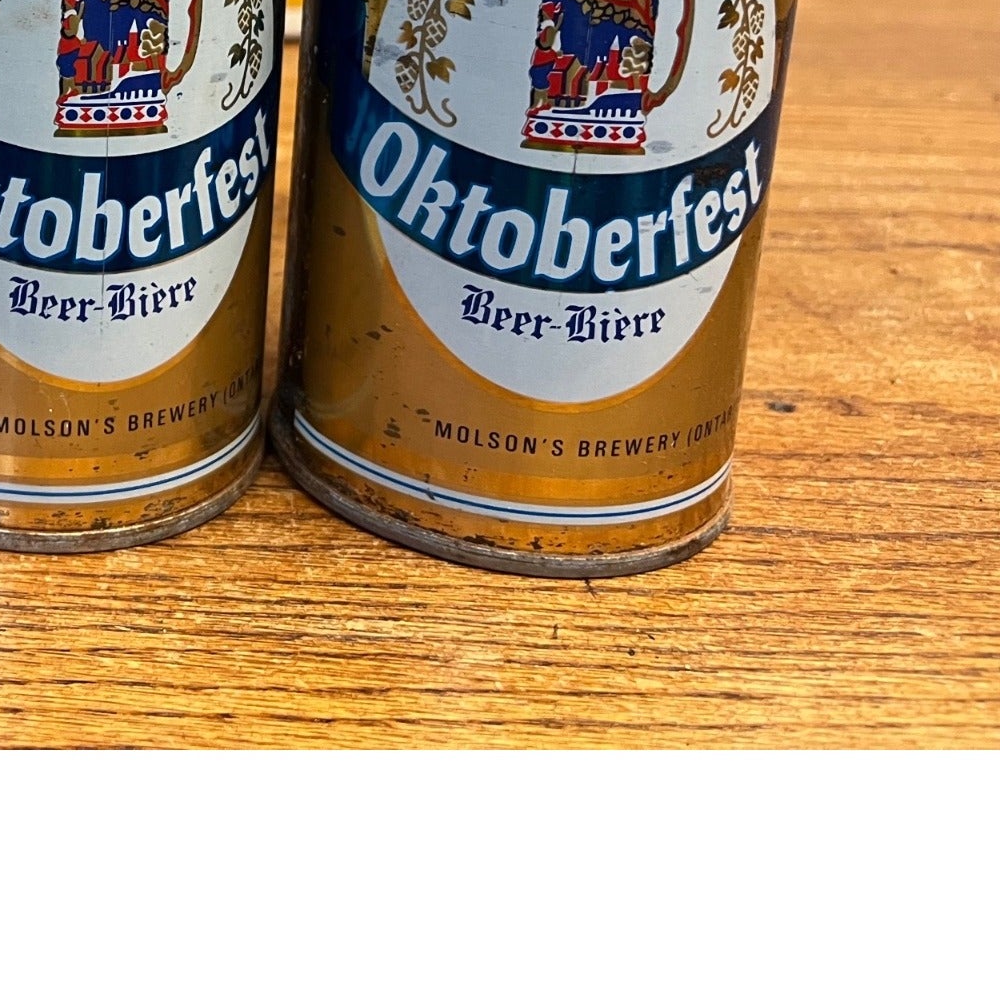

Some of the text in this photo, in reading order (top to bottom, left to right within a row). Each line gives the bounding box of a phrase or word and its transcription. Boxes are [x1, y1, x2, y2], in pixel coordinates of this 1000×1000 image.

[359, 120, 764, 283] Oktoberfest
[8, 275, 198, 323] Beer-Bière
[459, 284, 667, 344] Beer-Bière
[128, 390, 218, 433] BREWERY
[434, 418, 565, 458] MOLSON'S
[577, 430, 681, 458] BREWERY
